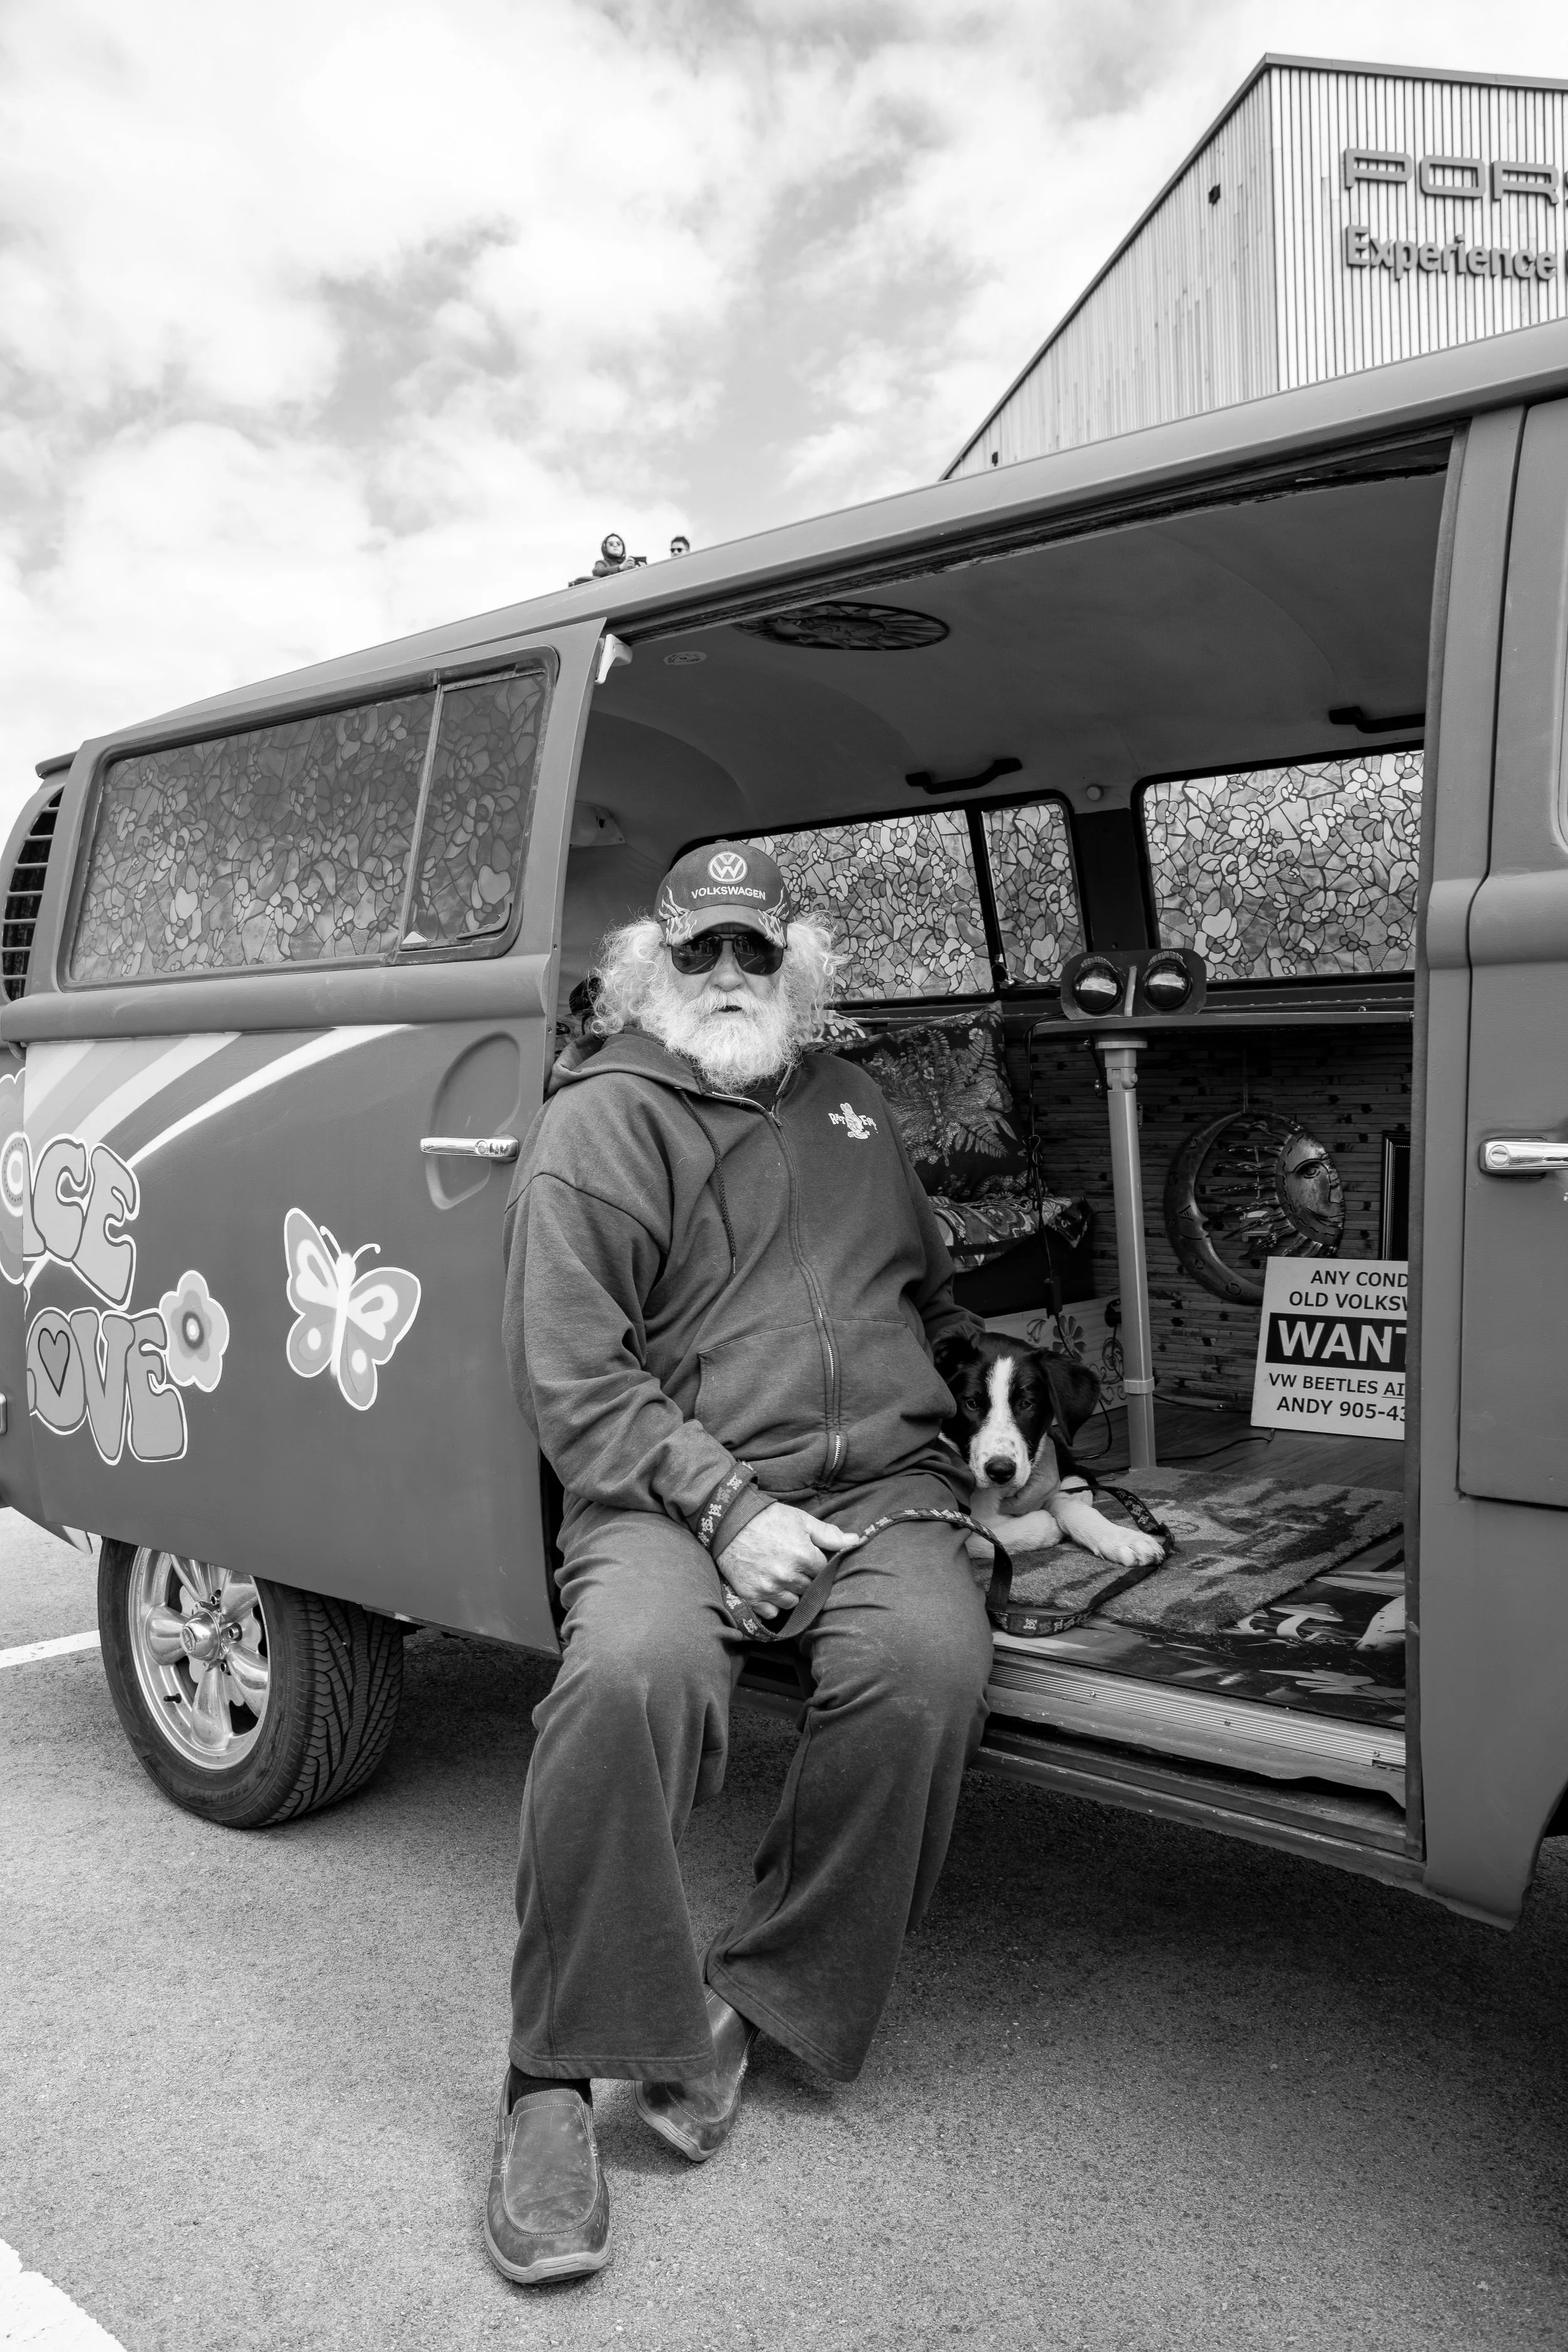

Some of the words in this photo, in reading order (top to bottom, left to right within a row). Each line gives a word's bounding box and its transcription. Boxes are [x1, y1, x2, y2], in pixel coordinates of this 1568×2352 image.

[1344, 147, 1568, 204] POR
[1345, 225, 1557, 281] Experience
[691, 886, 766, 901] VOLKSWAGEN
[1310, 1270, 1350, 1286] ANY
[1356, 1271, 1408, 1288] COND
[1289, 1291, 1328, 1308] OLD
[1278, 1320, 1407, 1364] WAN
[25, 1306, 188, 1466] OVE
[1269, 1373, 1297, 1388] VW
[1303, 1375, 1378, 1394] BEETLES
[1276, 1396, 1333, 1414] ANDY
